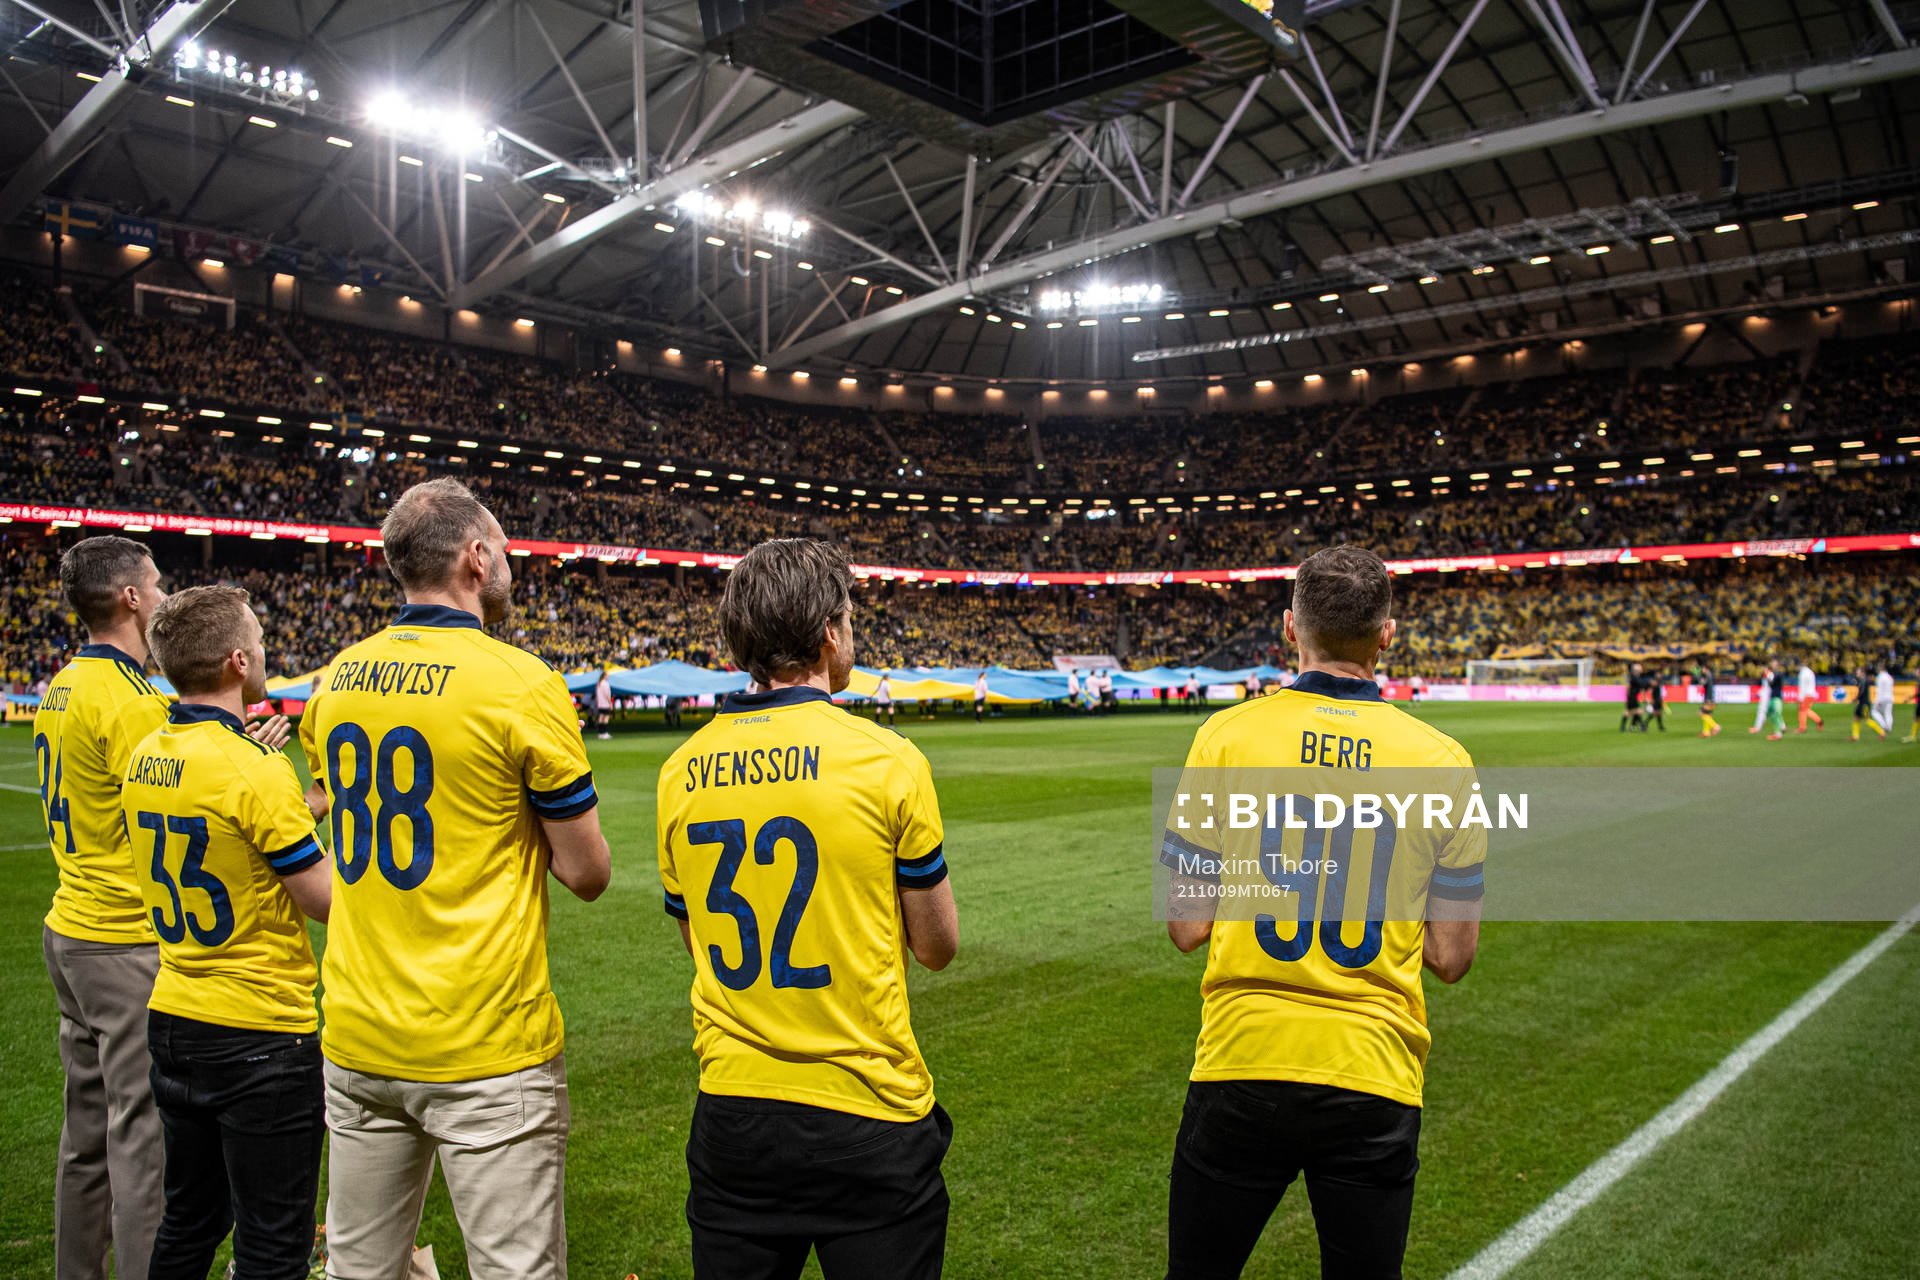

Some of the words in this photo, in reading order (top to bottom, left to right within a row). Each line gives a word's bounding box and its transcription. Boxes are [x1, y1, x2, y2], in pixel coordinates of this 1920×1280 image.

[119, 223, 154, 239] FIFA
[331, 660, 456, 696] GRANQVIST
[128, 753, 186, 789] LARSSON
[686, 746, 820, 792] SVENSSON
[1300, 730, 1372, 772] BERG
[327, 722, 434, 891] 88
[138, 811, 235, 947] 33
[1254, 793, 1397, 969] 90
[687, 816, 832, 990] 32
